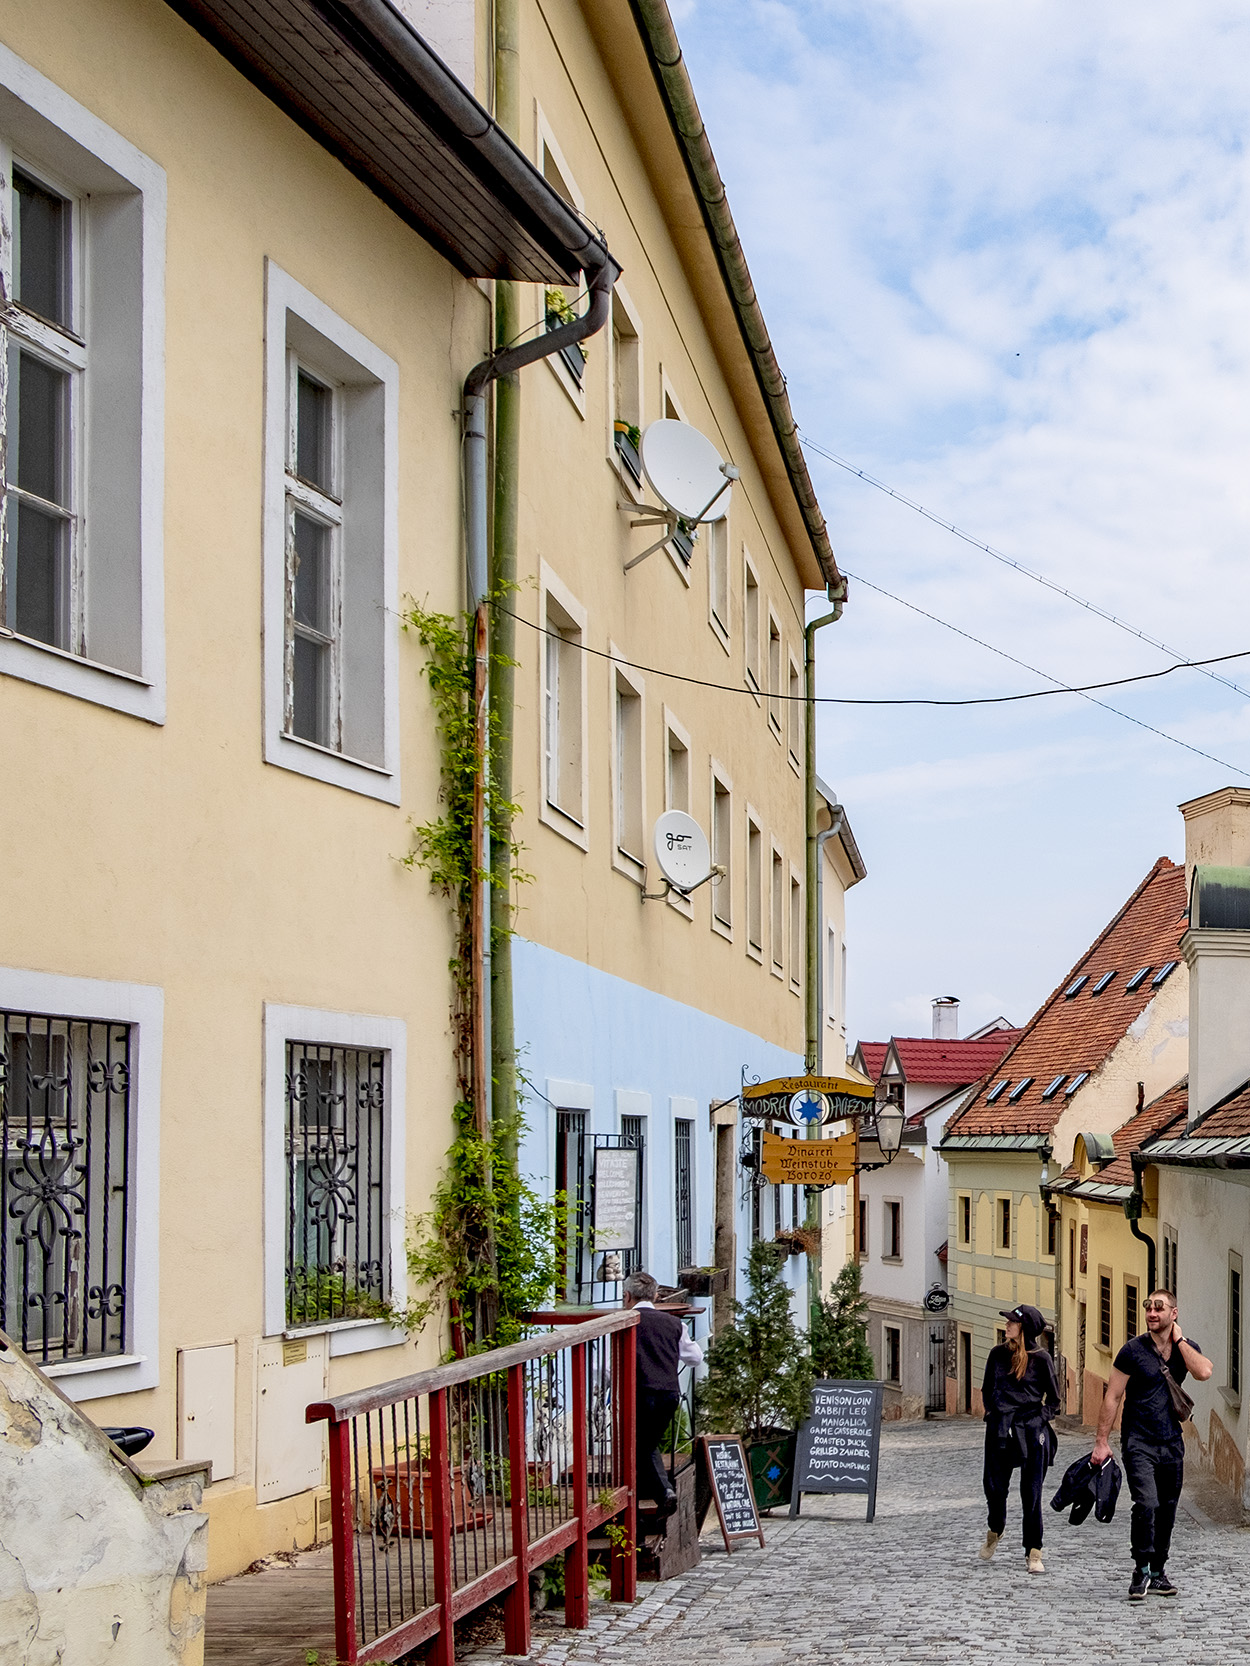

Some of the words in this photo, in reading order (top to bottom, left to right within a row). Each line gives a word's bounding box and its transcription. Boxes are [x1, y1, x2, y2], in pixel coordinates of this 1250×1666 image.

[780, 1080, 838, 1090] Restaurant
[829, 1097, 873, 1118] HVIEZDA
[780, 1160, 839, 1169] Weinstube
[786, 1170, 833, 1181] Borozó
[815, 1395, 852, 1405] VENISON
[852, 1397, 872, 1406] LOIN
[814, 1406, 847, 1416] RABBIT
[849, 1407, 867, 1415] LEG
[821, 1418, 867, 1427] MANGALICA
[809, 1426, 834, 1436] GAME
[834, 1427, 872, 1437] CASSEROLE
[814, 1436, 846, 1447] ROASTED
[847, 1438, 867, 1448] DUCK
[809, 1446, 839, 1456] GRILLED
[839, 1447, 871, 1459] ZANDER
[809, 1458, 839, 1469] POTATO
[839, 1461, 871, 1472] DUMPLINGS
